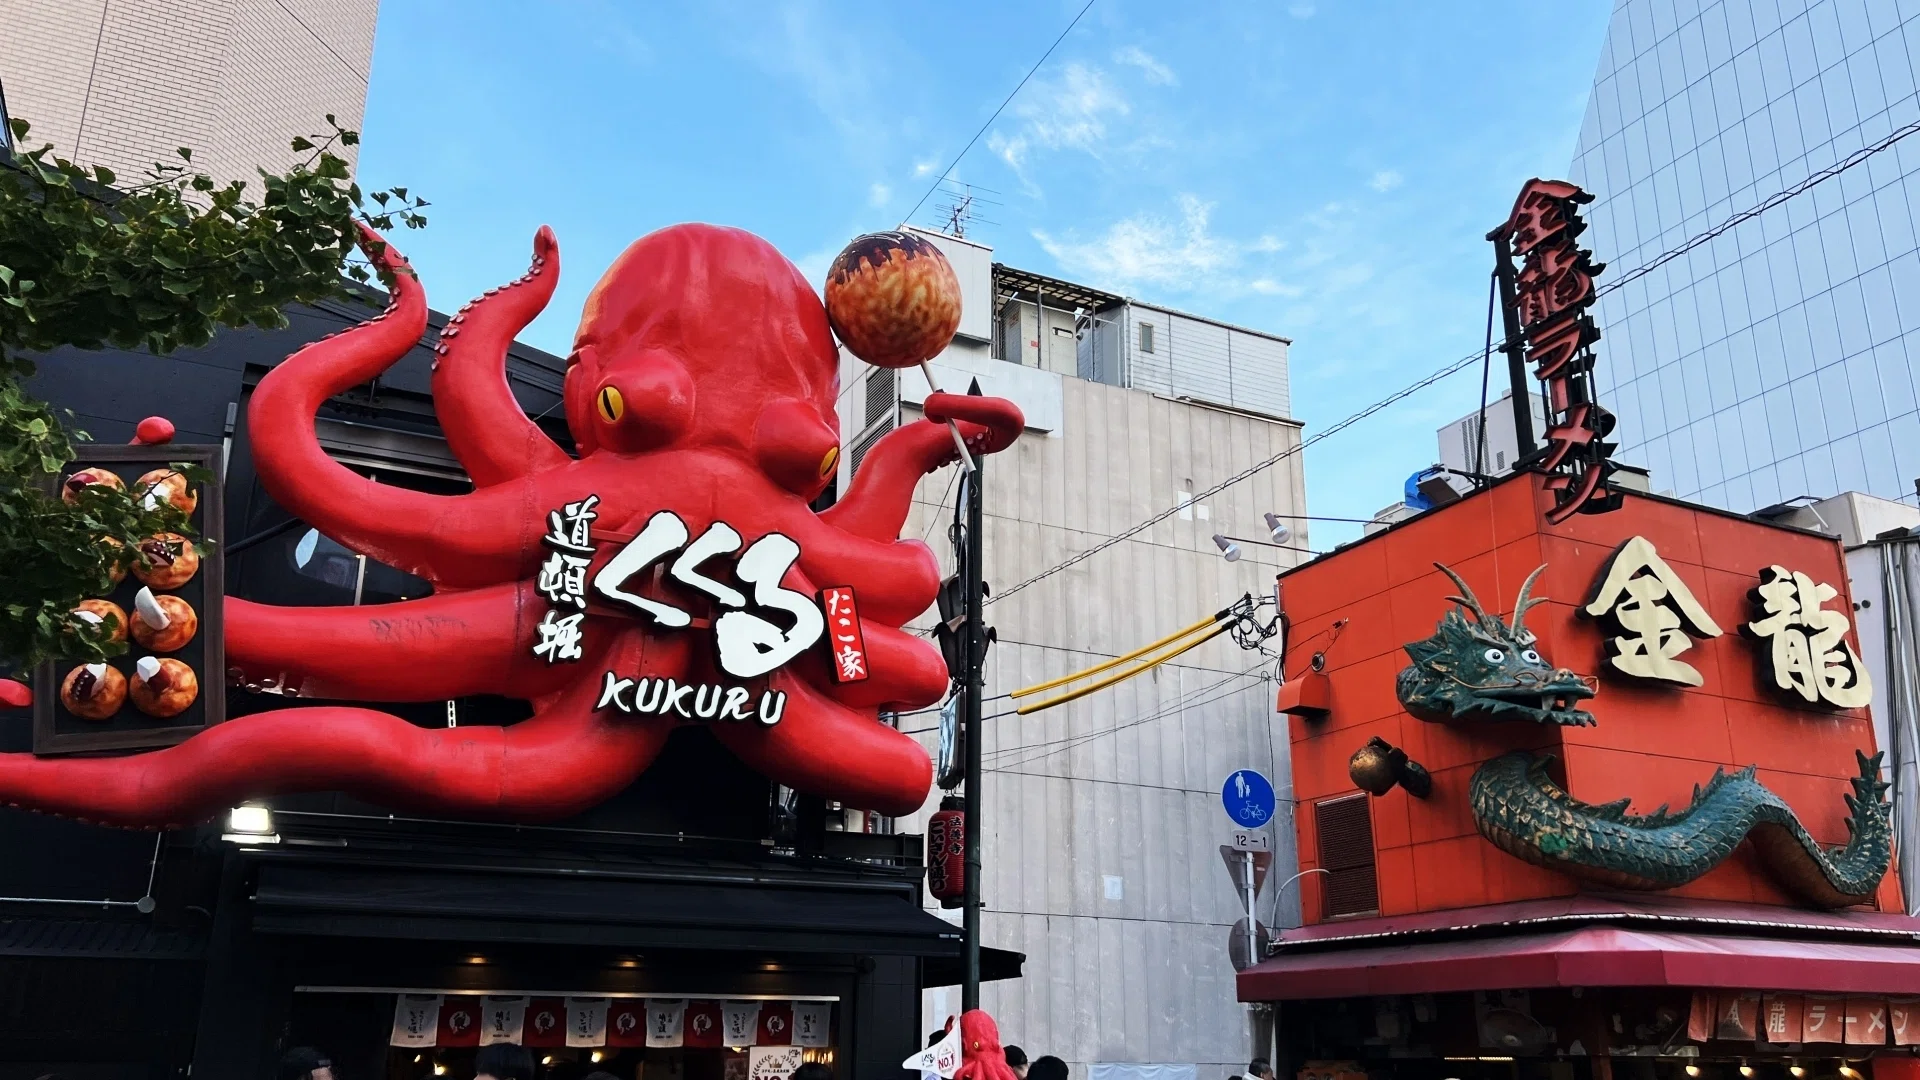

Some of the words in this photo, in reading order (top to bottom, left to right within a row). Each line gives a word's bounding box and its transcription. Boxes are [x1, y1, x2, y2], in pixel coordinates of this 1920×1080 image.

[1500, 178, 1602, 525] 金龍ラーメン
[533, 495, 599, 662] 道頓堀
[594, 511, 824, 678] くくる
[828, 589, 866, 680] たこ家
[1585, 535, 1873, 708] 金龍
[597, 671, 786, 725] KUKURU
[948, 815, 964, 856] 法善寺
[938, 1053, 955, 1070] NO.1
